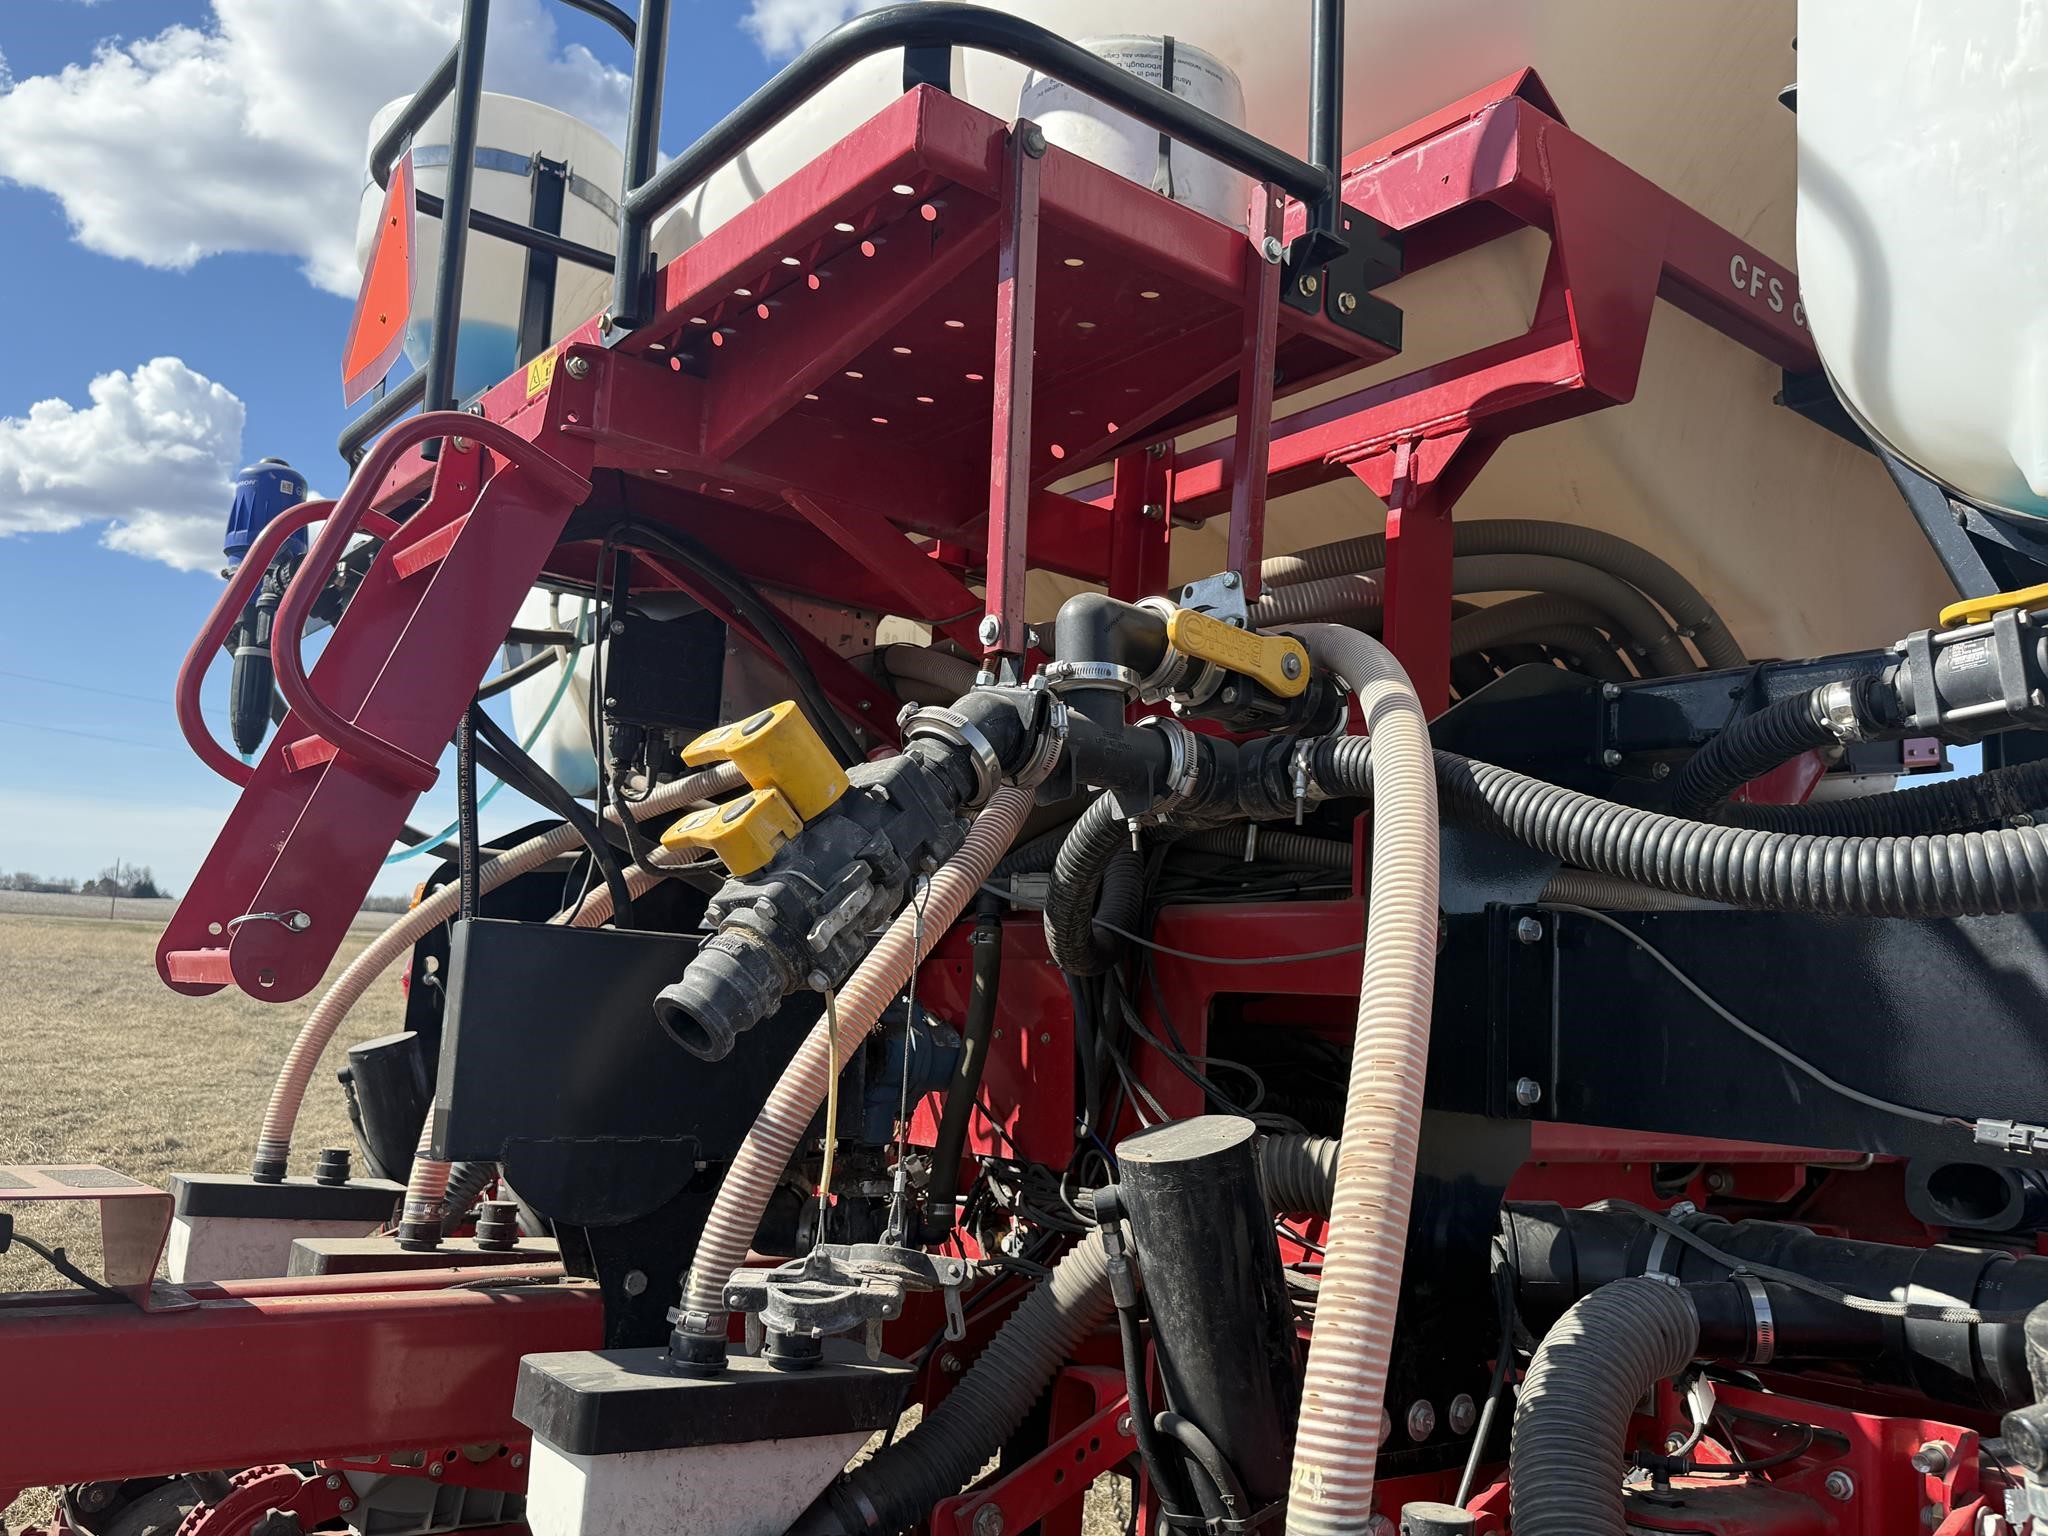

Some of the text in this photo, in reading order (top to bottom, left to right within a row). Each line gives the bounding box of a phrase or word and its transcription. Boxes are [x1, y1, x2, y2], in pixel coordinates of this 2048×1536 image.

[1730, 255, 1783, 313] CFS
[461, 752, 469, 769] MPa
[463, 840, 471, 870] COVER
[463, 873, 471, 909] TOUGH
